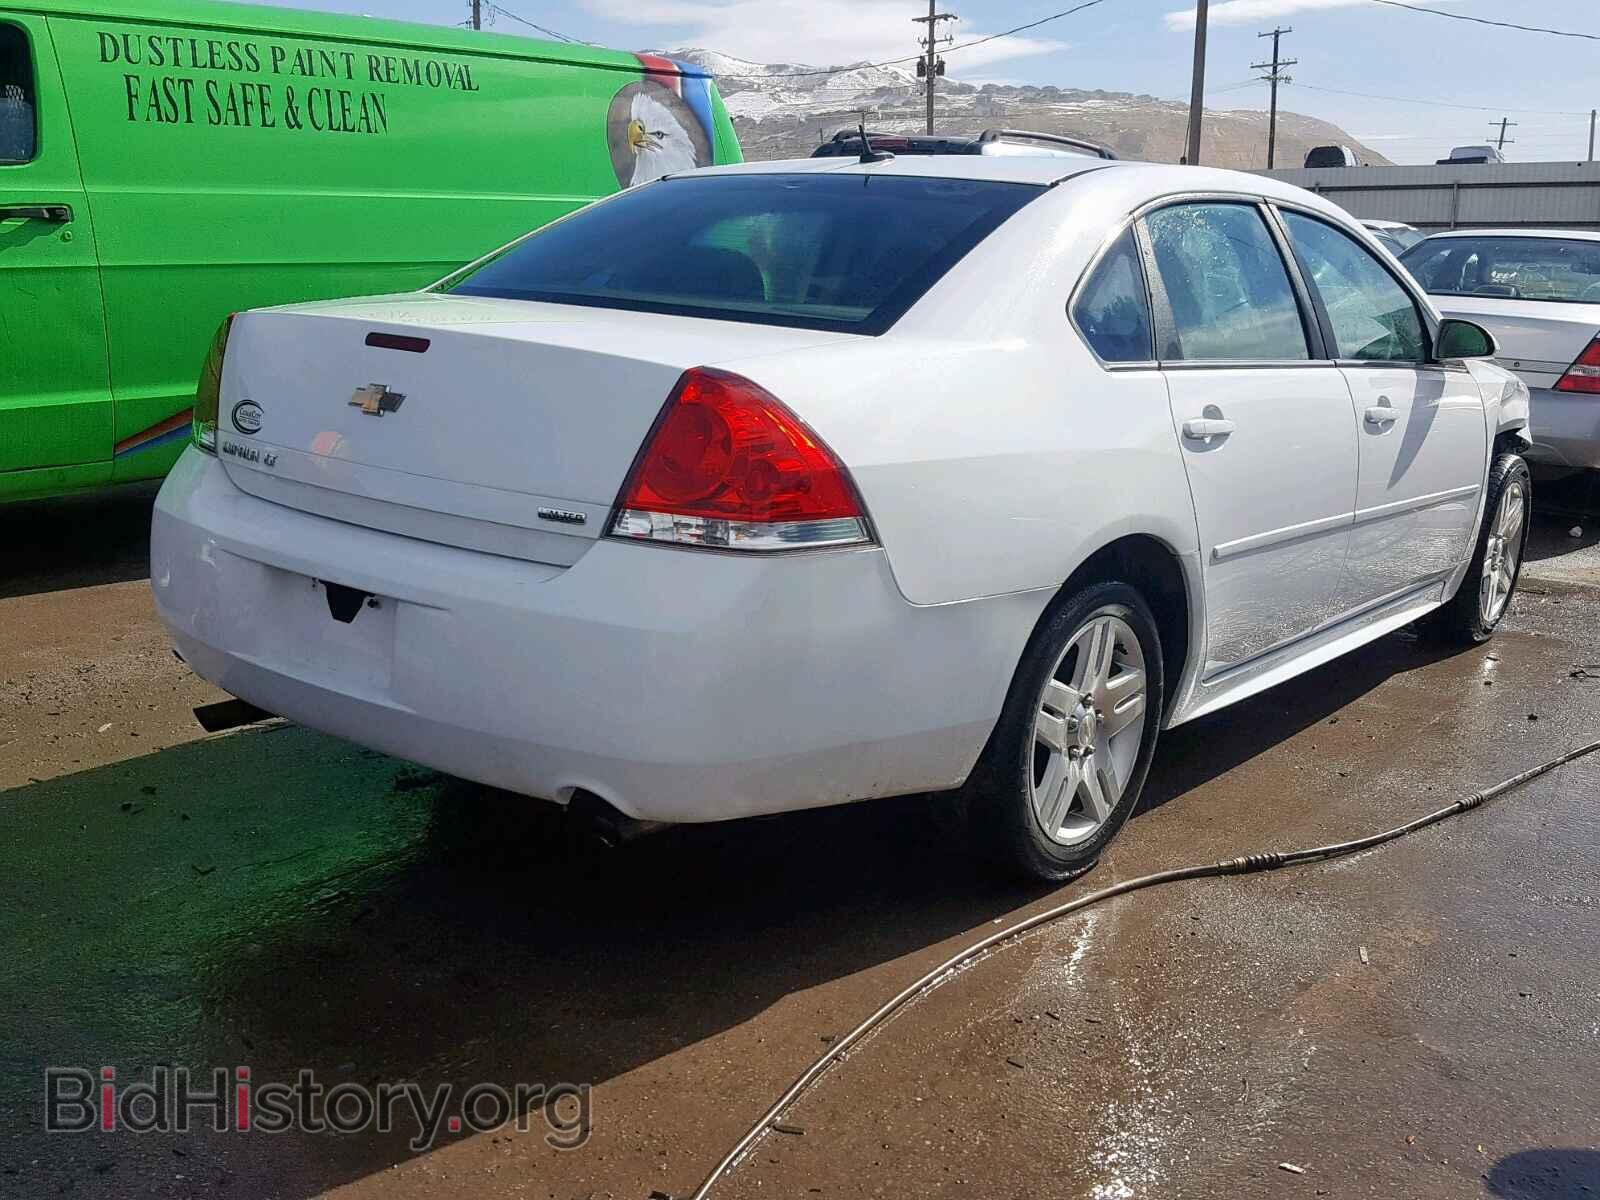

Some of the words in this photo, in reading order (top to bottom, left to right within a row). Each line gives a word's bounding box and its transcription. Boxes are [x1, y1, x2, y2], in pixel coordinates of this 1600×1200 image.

[96, 31, 261, 73] DUSTLESS
[271, 45, 355, 81] PAINT
[367, 54, 480, 91] REMOVAL
[123, 74, 195, 125] FAST
[205, 79, 276, 128] SAFE
[284, 84, 303, 130] &
[307, 86, 389, 136] CLEAN
